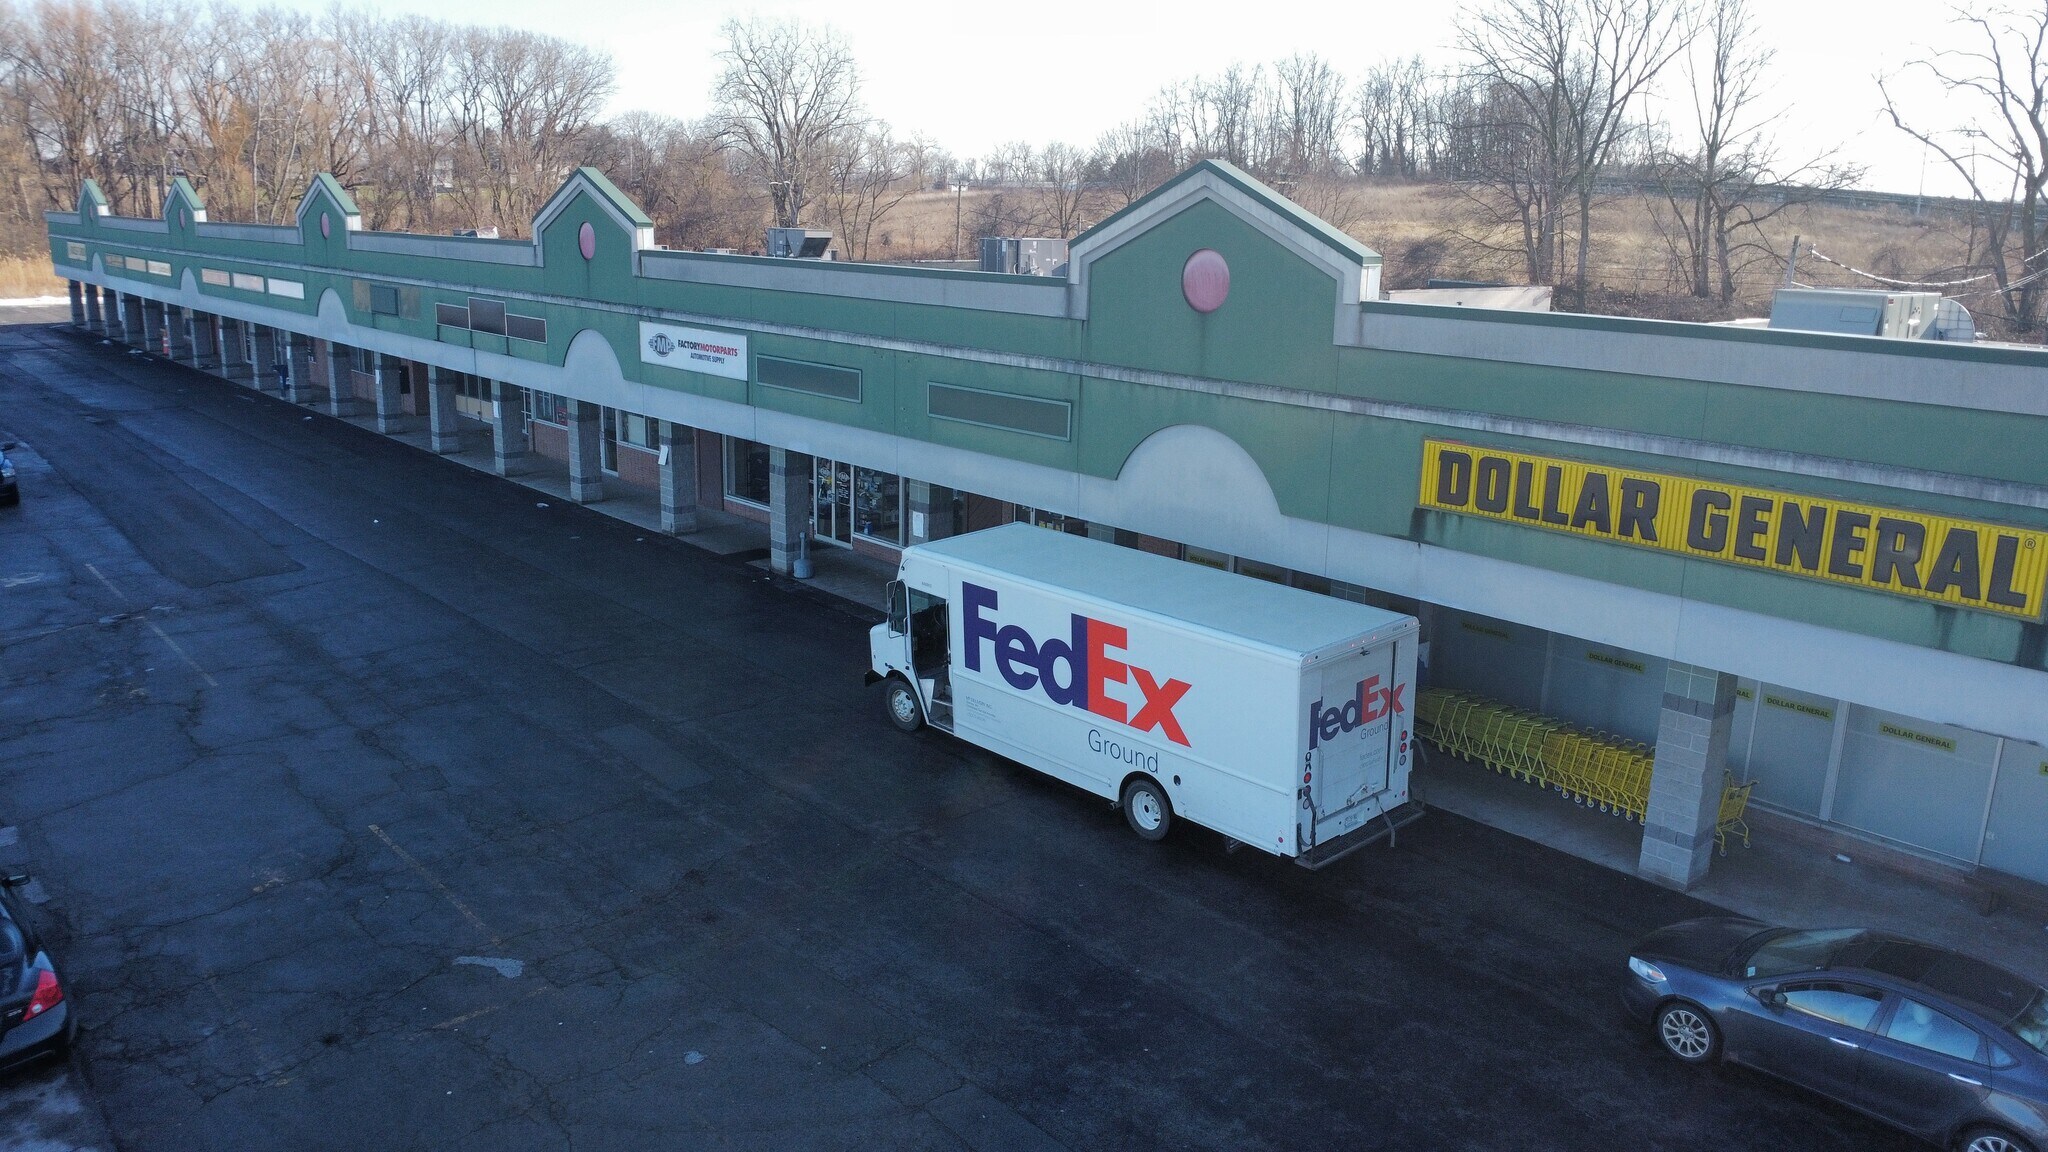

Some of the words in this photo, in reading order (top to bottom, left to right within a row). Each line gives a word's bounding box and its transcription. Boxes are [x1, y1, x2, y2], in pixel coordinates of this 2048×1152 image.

[678, 339, 738, 357] FACTORYMOTORPARTS
[690, 352, 711, 363] AUTOMOTIVE
[712, 356, 725, 364] SUPPLY
[1437, 449, 1660, 542] DOLLAR
[962, 581, 1192, 748] FedEx
[1589, 653, 1613, 665] DOLLAR
[1614, 659, 1643, 672] GENERAL
[1309, 674, 1406, 750] FedEx
[1767, 697, 1795, 710] DOLLAR
[1796, 704, 1830, 719] GENERAL
[1360, 721, 1388, 740] Ground
[1883, 725, 1913, 739] DOLLAR
[1915, 731, 1952, 749] GENERAL
[1088, 729, 1159, 774] Ground
